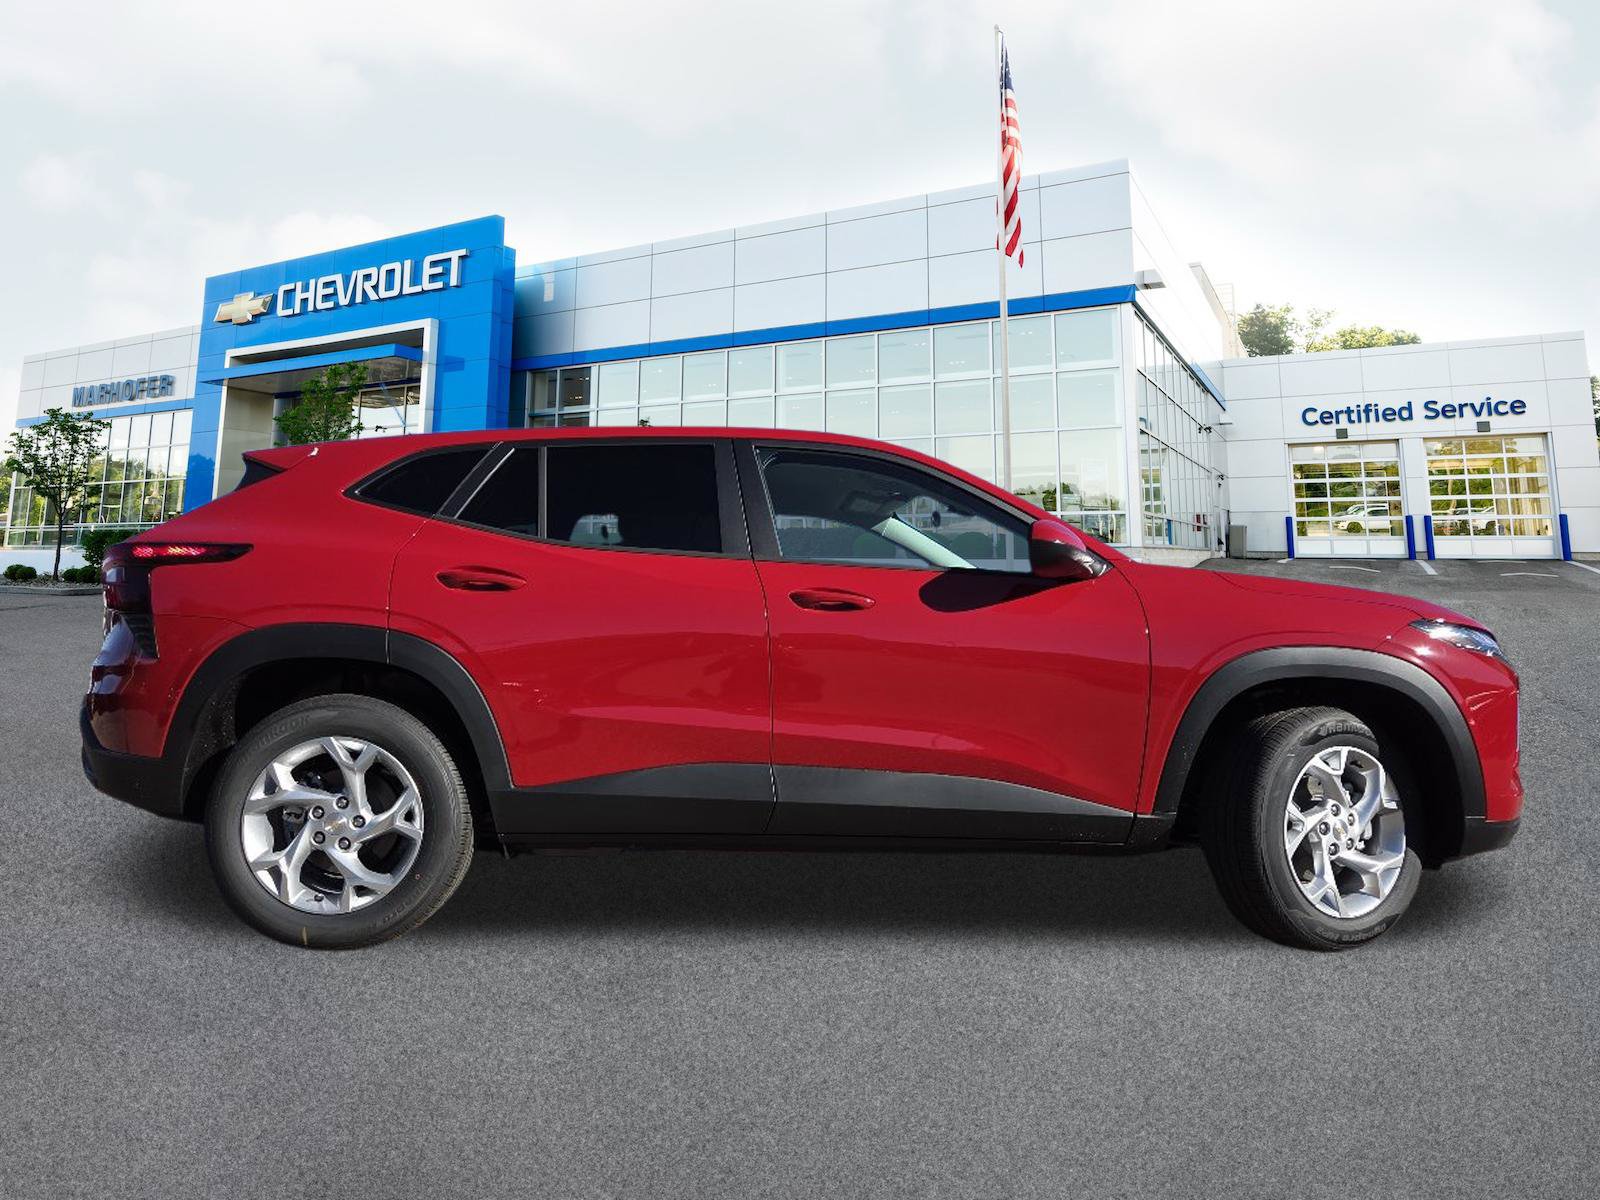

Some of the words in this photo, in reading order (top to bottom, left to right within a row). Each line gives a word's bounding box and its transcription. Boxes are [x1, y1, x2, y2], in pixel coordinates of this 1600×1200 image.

[276, 248, 470, 318] CHEVROLET
[72, 374, 176, 407] MARHOFER
[1301, 401, 1414, 427] Certified
[1423, 396, 1528, 420] Service
